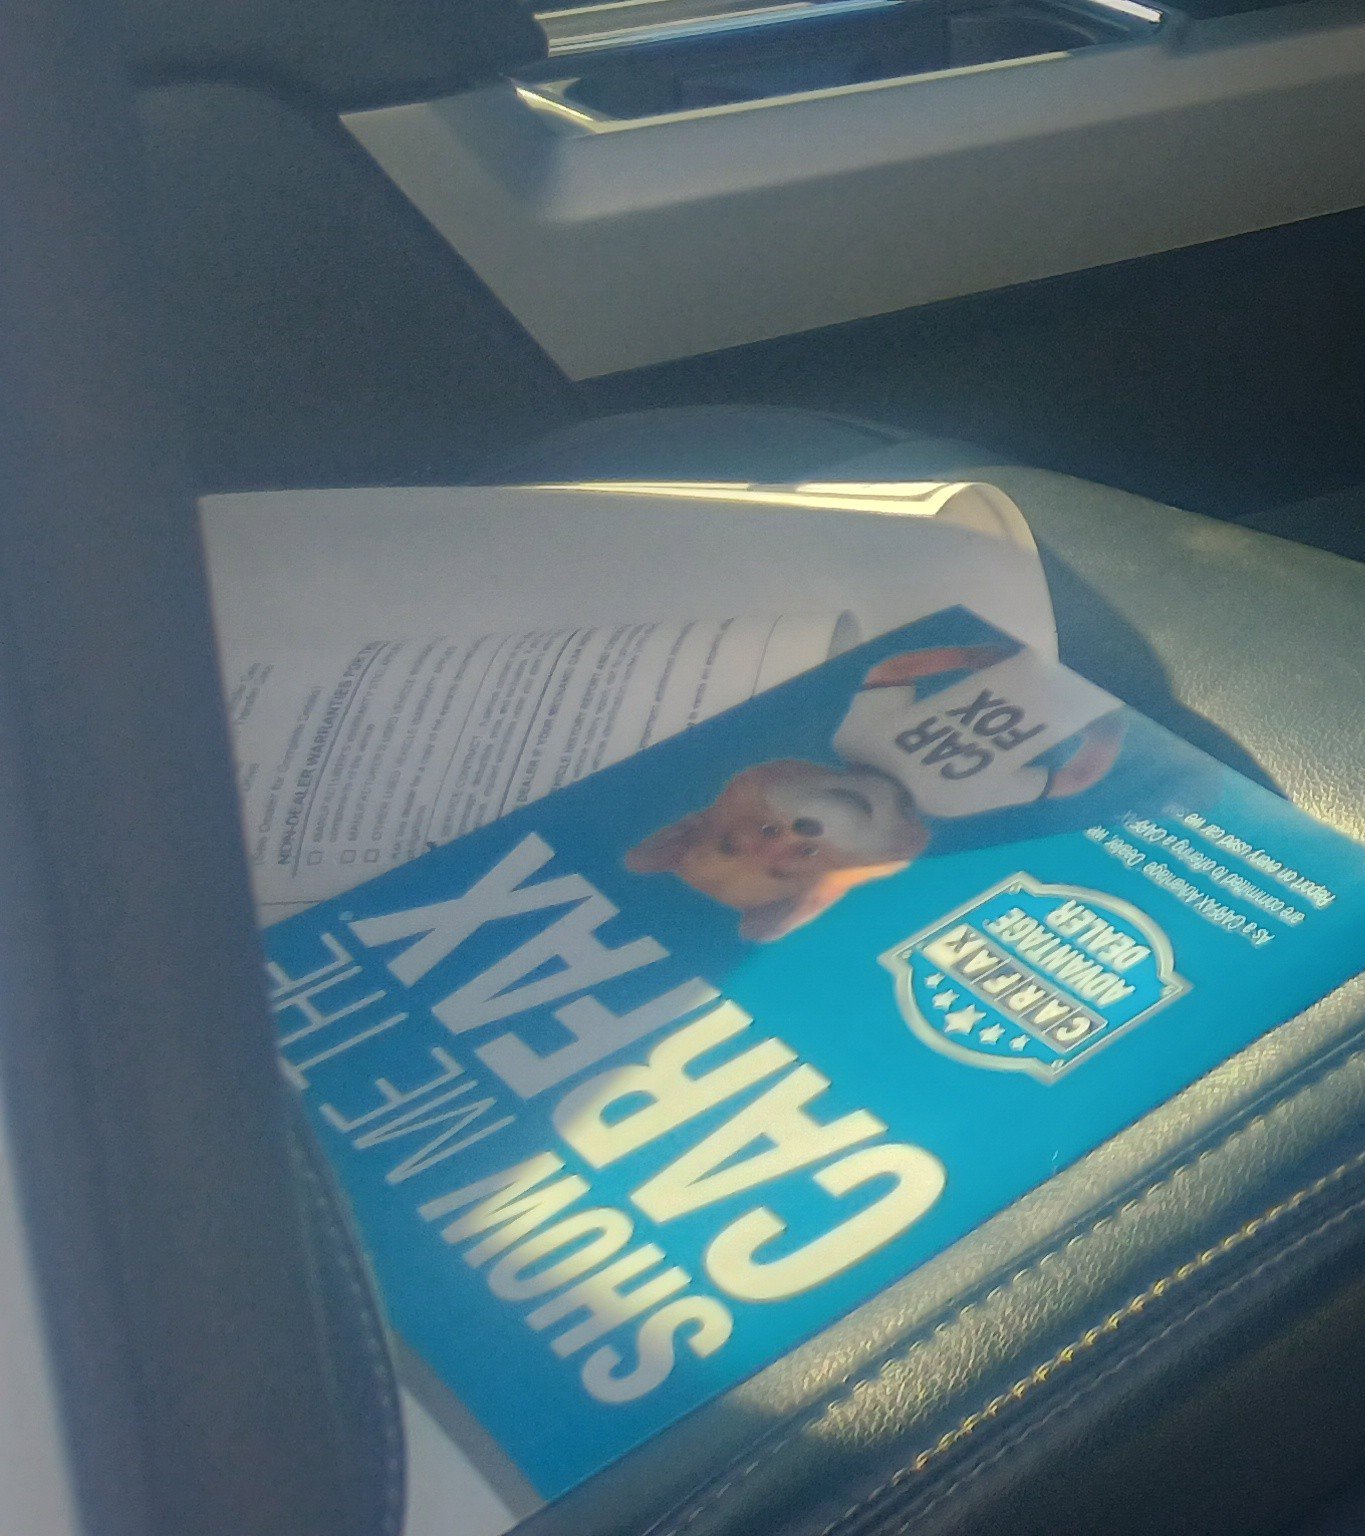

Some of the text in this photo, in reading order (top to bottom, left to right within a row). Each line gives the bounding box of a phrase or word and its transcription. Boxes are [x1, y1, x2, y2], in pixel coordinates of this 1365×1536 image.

[304, 679, 353, 766] WARRANTIES
[893, 715, 996, 781] CAR
[948, 687, 1049, 752] FOX
[1170, 839, 1221, 871] offering
[1185, 814, 1338, 906] Report on every used car we
[1222, 874, 1285, 913] committed
[1045, 899, 1152, 972] DEALER
[1193, 896, 1247, 929] CARFAX
[1249, 929, 1274, 945] As
[1281, 908, 1305, 923] are
[942, 927, 1093, 1044] CARFAX
[987, 906, 1136, 1008] ADVANTAGE
[265, 931, 407, 1091] THE
[348, 831, 947, 1303] CARFAX
[316, 1044, 516, 1185] ME
[417, 1150, 733, 1404] SHOW
